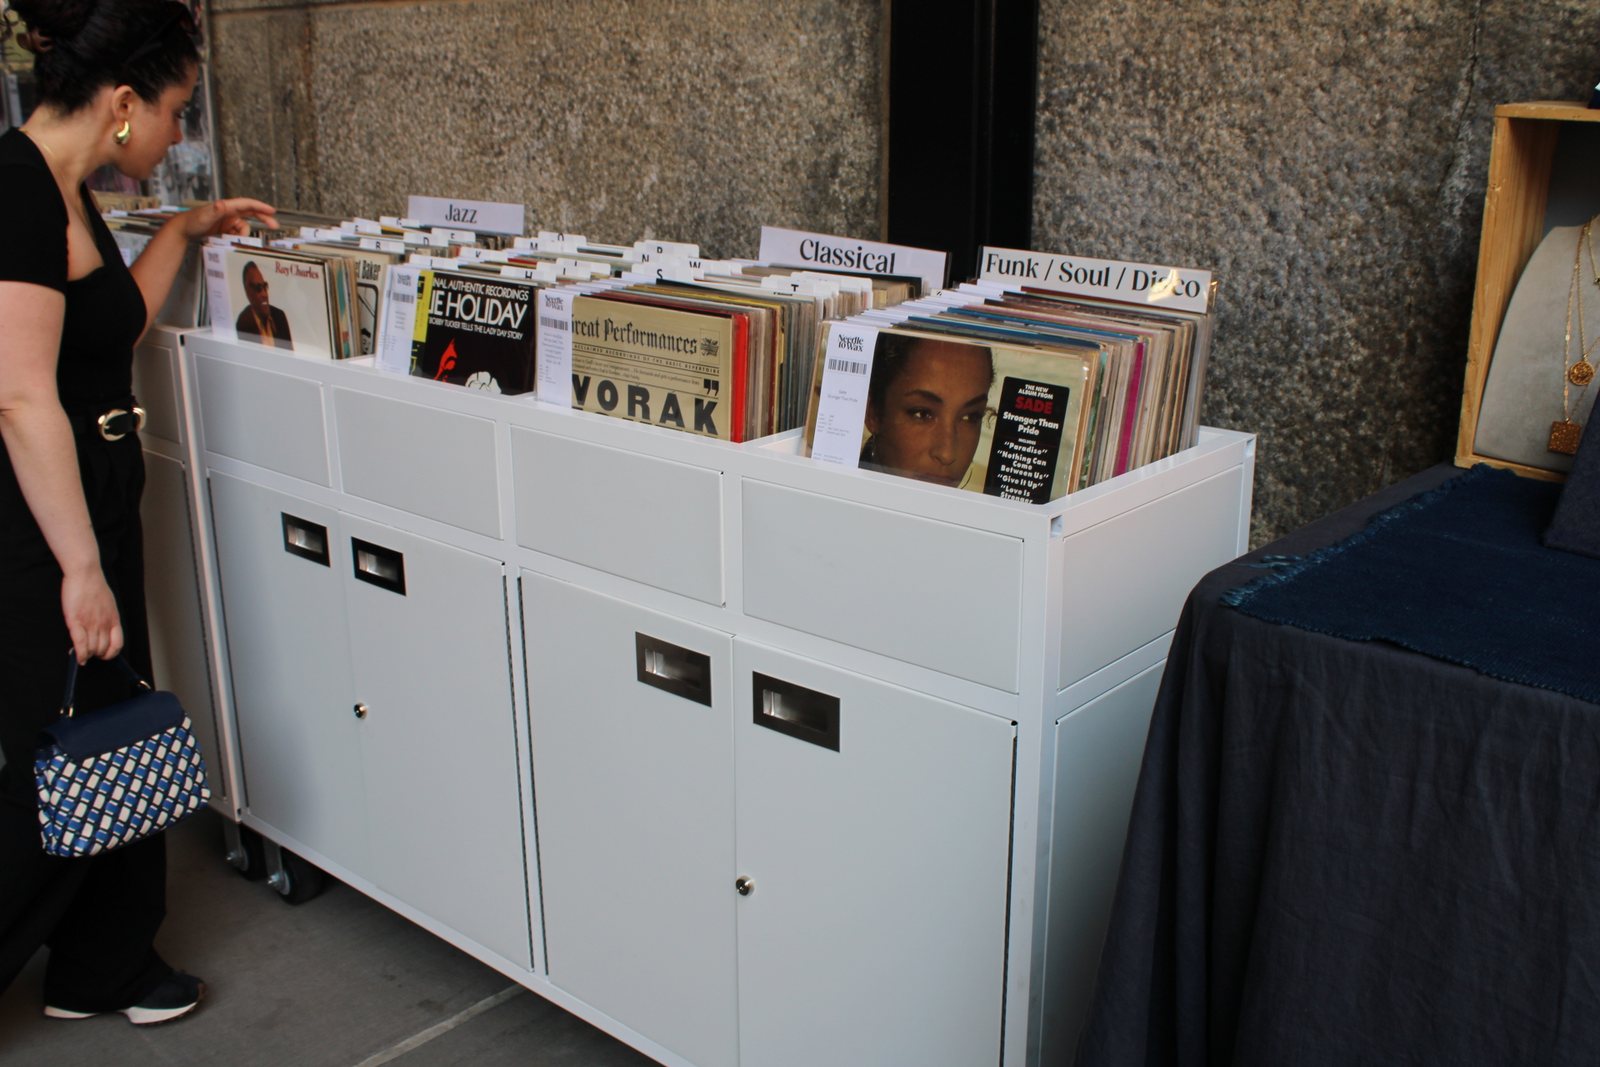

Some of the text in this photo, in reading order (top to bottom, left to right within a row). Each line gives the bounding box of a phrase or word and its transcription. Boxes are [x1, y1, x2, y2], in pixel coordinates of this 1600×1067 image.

[445, 204, 477, 224] Jazz
[800, 239, 896, 274] Classical
[275, 260, 320, 280] Ray Charles
[362, 260, 381, 281] Baker
[986, 253, 1040, 278] Funk
[1044, 259, 1054, 281] /
[1058, 261, 1110, 288] Soul
[1116, 267, 1126, 290] /
[447, 279, 486, 295] AUTHENTIC
[486, 285, 530, 302] RECORDINGS
[790, 284, 799, 292] T
[446, 292, 528, 329] HOLIDAY
[444, 319, 460, 330] TUCKER
[461, 322, 474, 332] TELLS
[474, 324, 483, 334] THE
[483, 326, 496, 336] LADY
[496, 328, 508, 338] DAY
[508, 330, 524, 340] STORY
[604, 317, 698, 355] Performances
[838, 334, 864, 345] Needle
[846, 342, 863, 352] Wax
[1018, 388, 1037, 397] ALBUM
[1015, 396, 1054, 414] SADE
[1003, 412, 1059, 429] Stronger Than
[1018, 424, 1039, 436] Pride
[1012, 460, 1033, 470] Come
[1032, 457, 1047, 466] Can
[1001, 464, 1033, 478] Between
